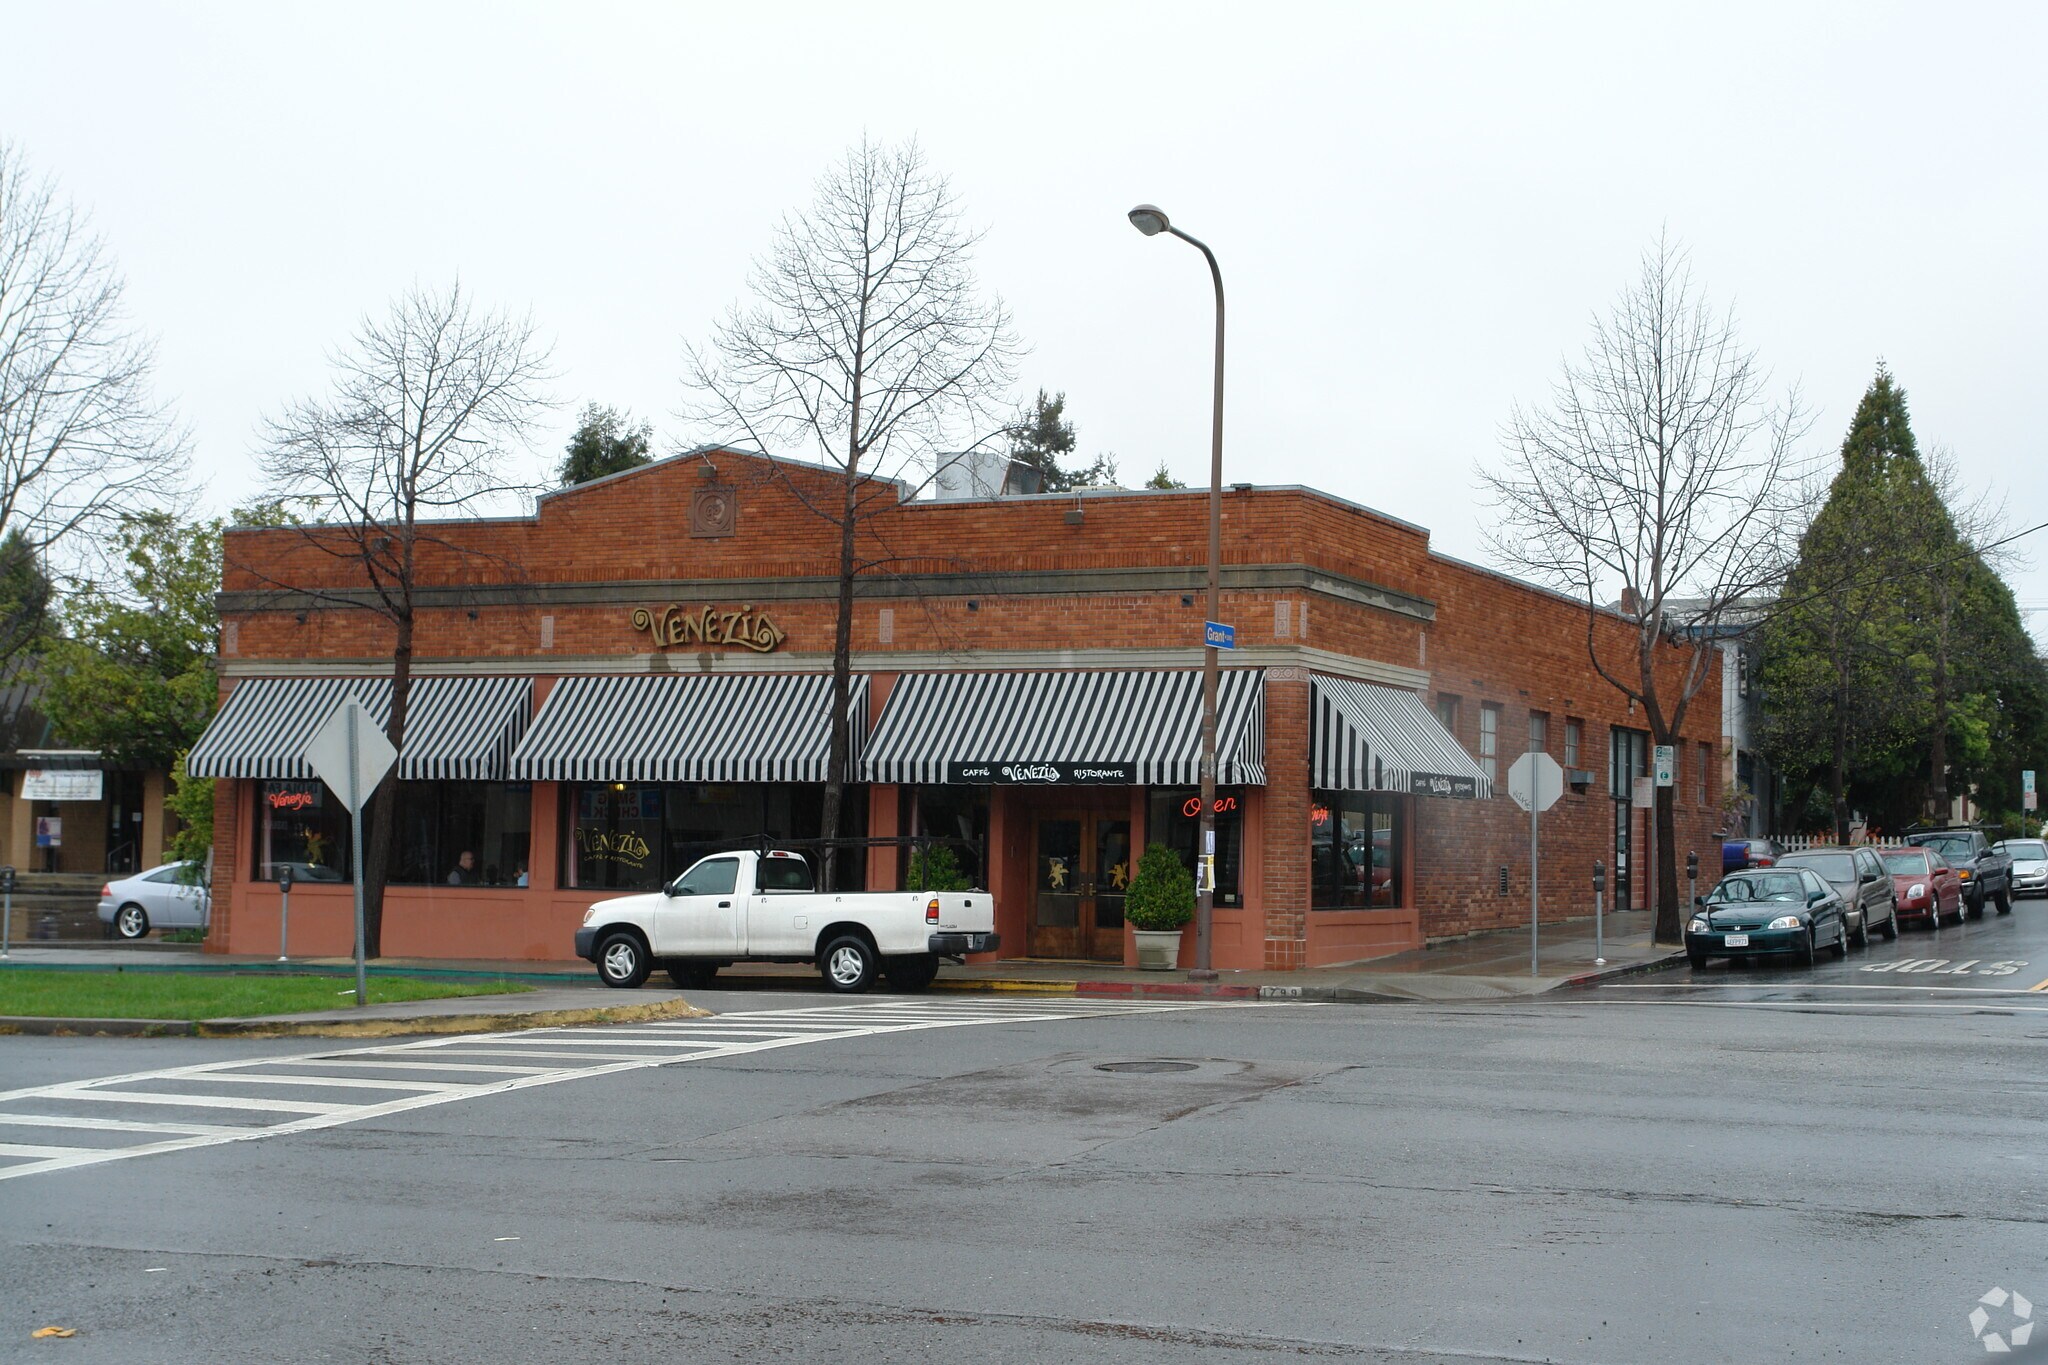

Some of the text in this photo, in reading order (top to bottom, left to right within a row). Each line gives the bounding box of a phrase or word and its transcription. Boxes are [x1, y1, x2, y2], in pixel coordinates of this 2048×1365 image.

[1207, 626, 1225, 643] Grant
[1073, 769, 1125, 779] RISTORANTE
[1183, 797, 1237, 817] Oen
[1859, 958, 2029, 976] STOP
